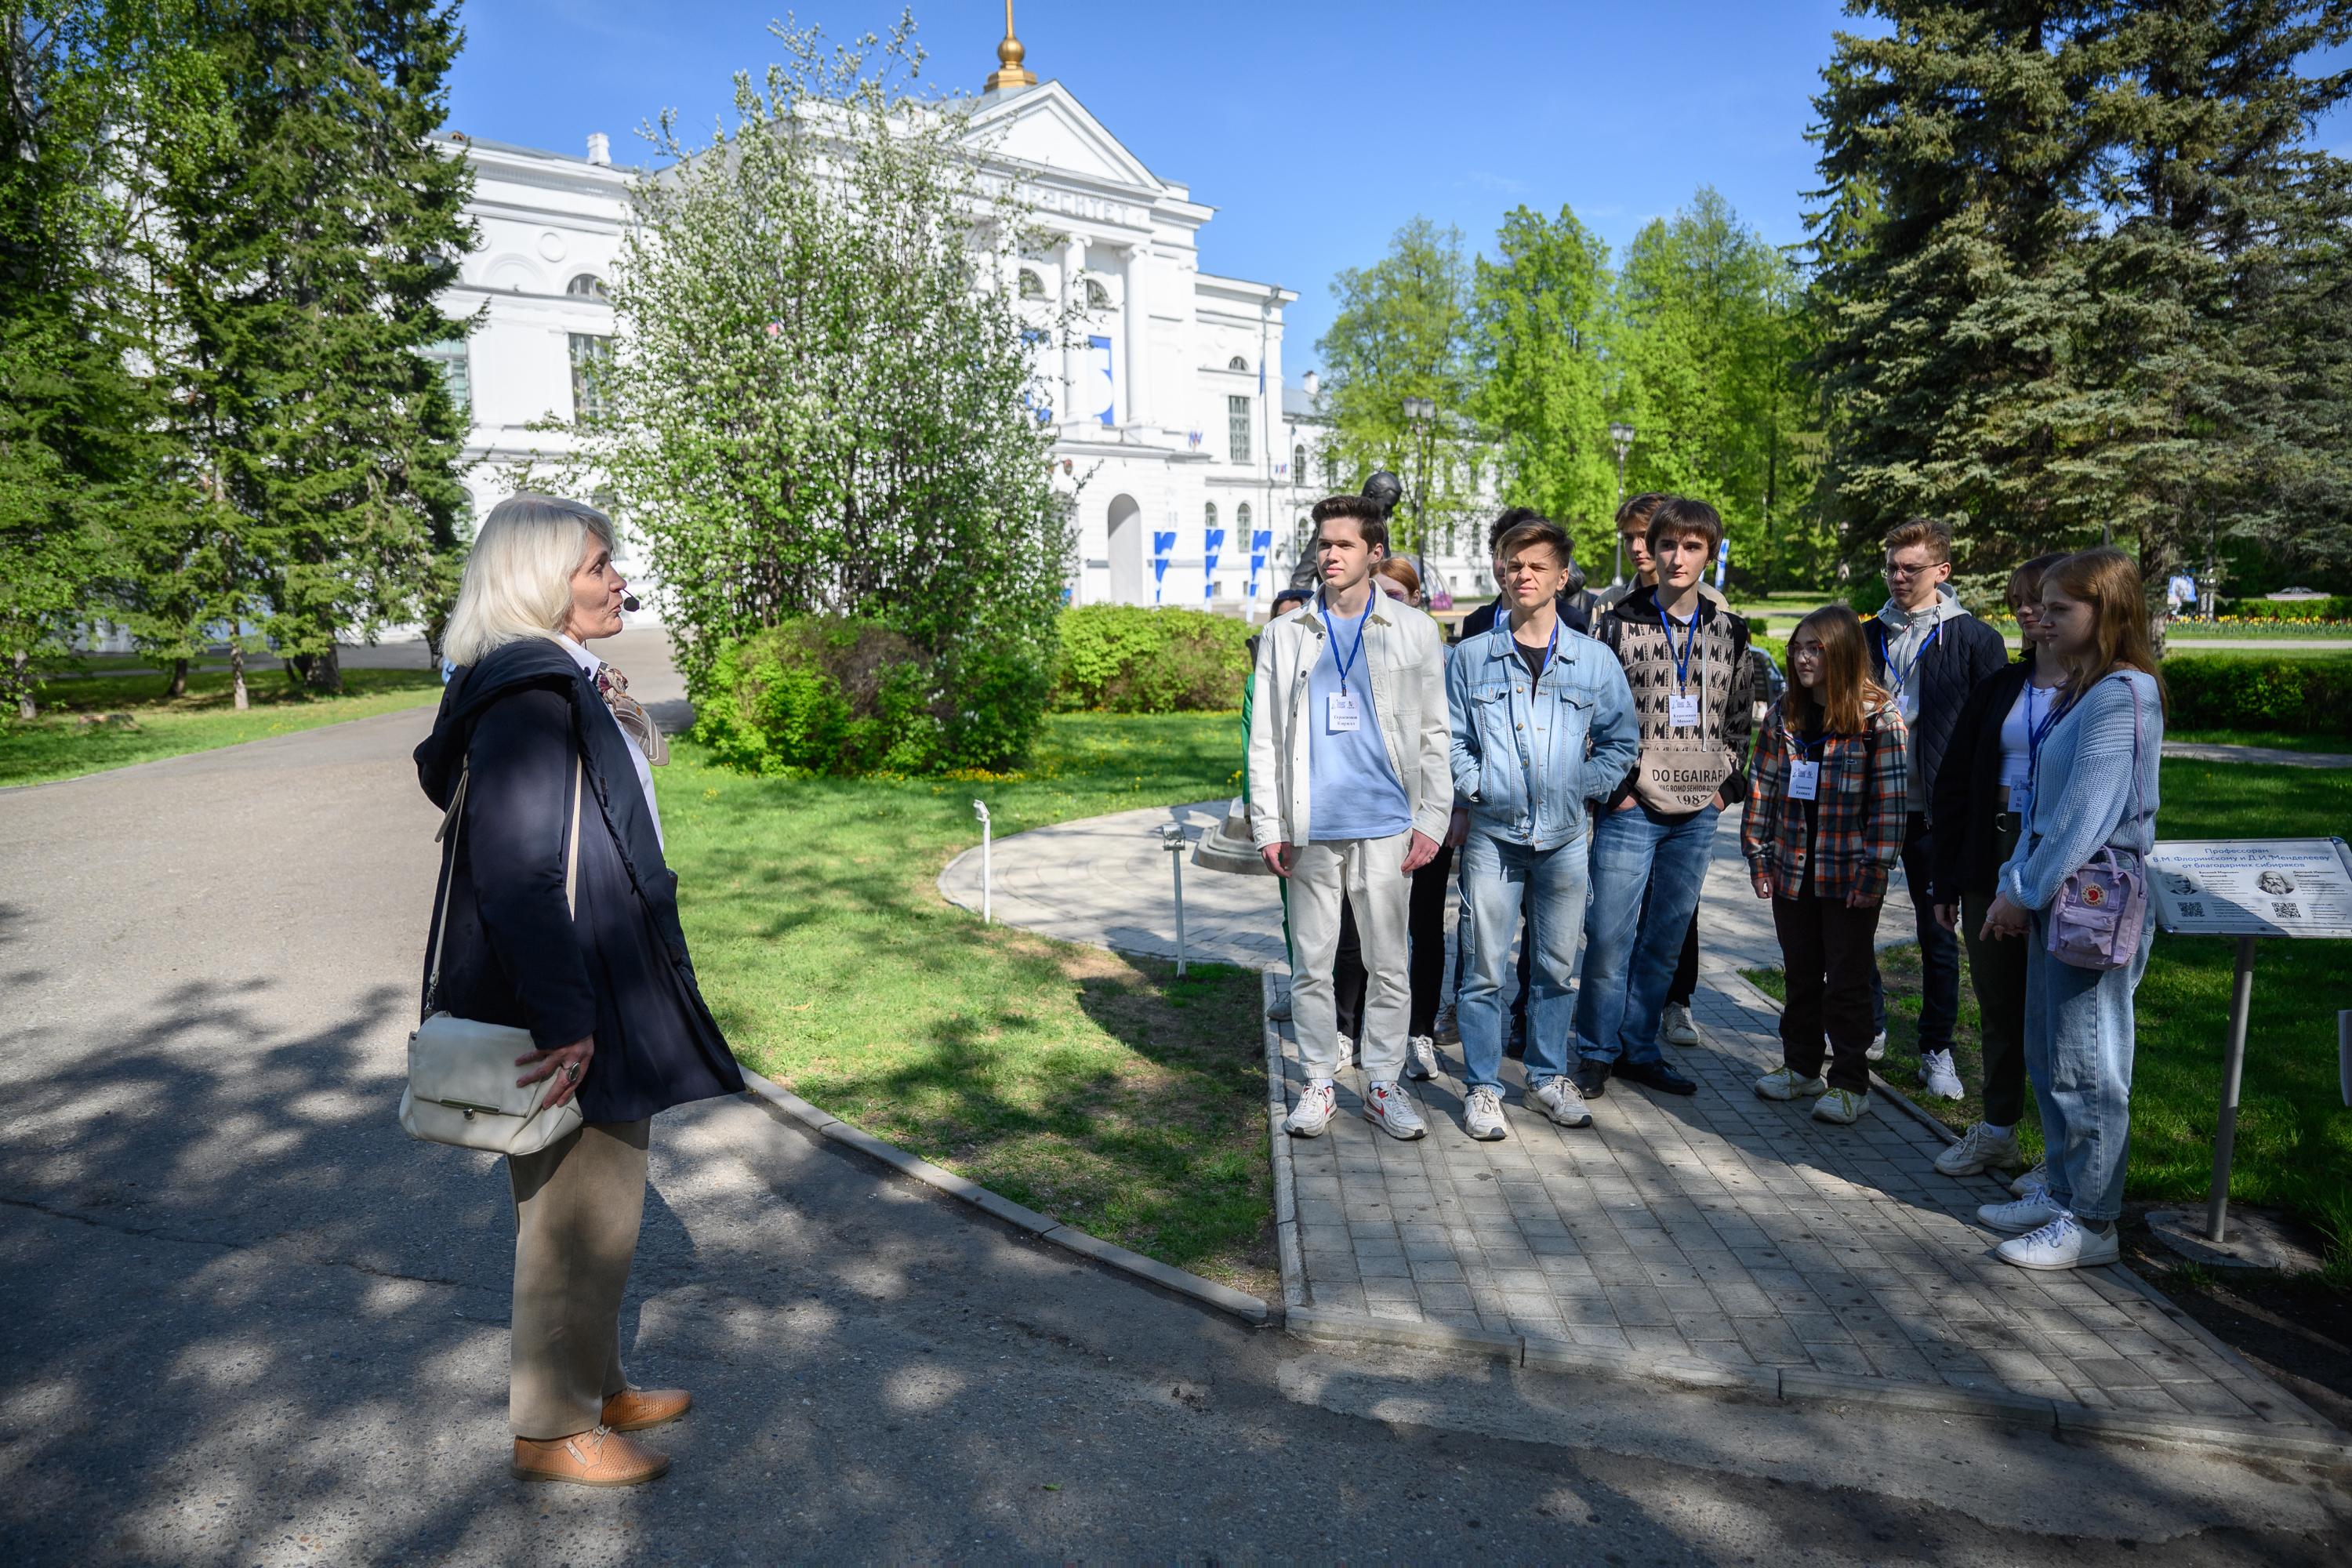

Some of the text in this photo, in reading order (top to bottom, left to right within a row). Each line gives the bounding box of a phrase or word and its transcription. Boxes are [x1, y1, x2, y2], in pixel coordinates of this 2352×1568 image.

[1632, 644, 1645, 665] M
[1652, 641, 1664, 661] M
[1709, 643, 1719, 662] M
[1723, 647, 1733, 666] M
[1634, 669, 1646, 688] M
[1652, 668, 1665, 688] M
[1635, 695, 1646, 713] M
[1652, 695, 1665, 713] M
[1652, 720, 1665, 739] M
[1652, 769, 1670, 782] DO
